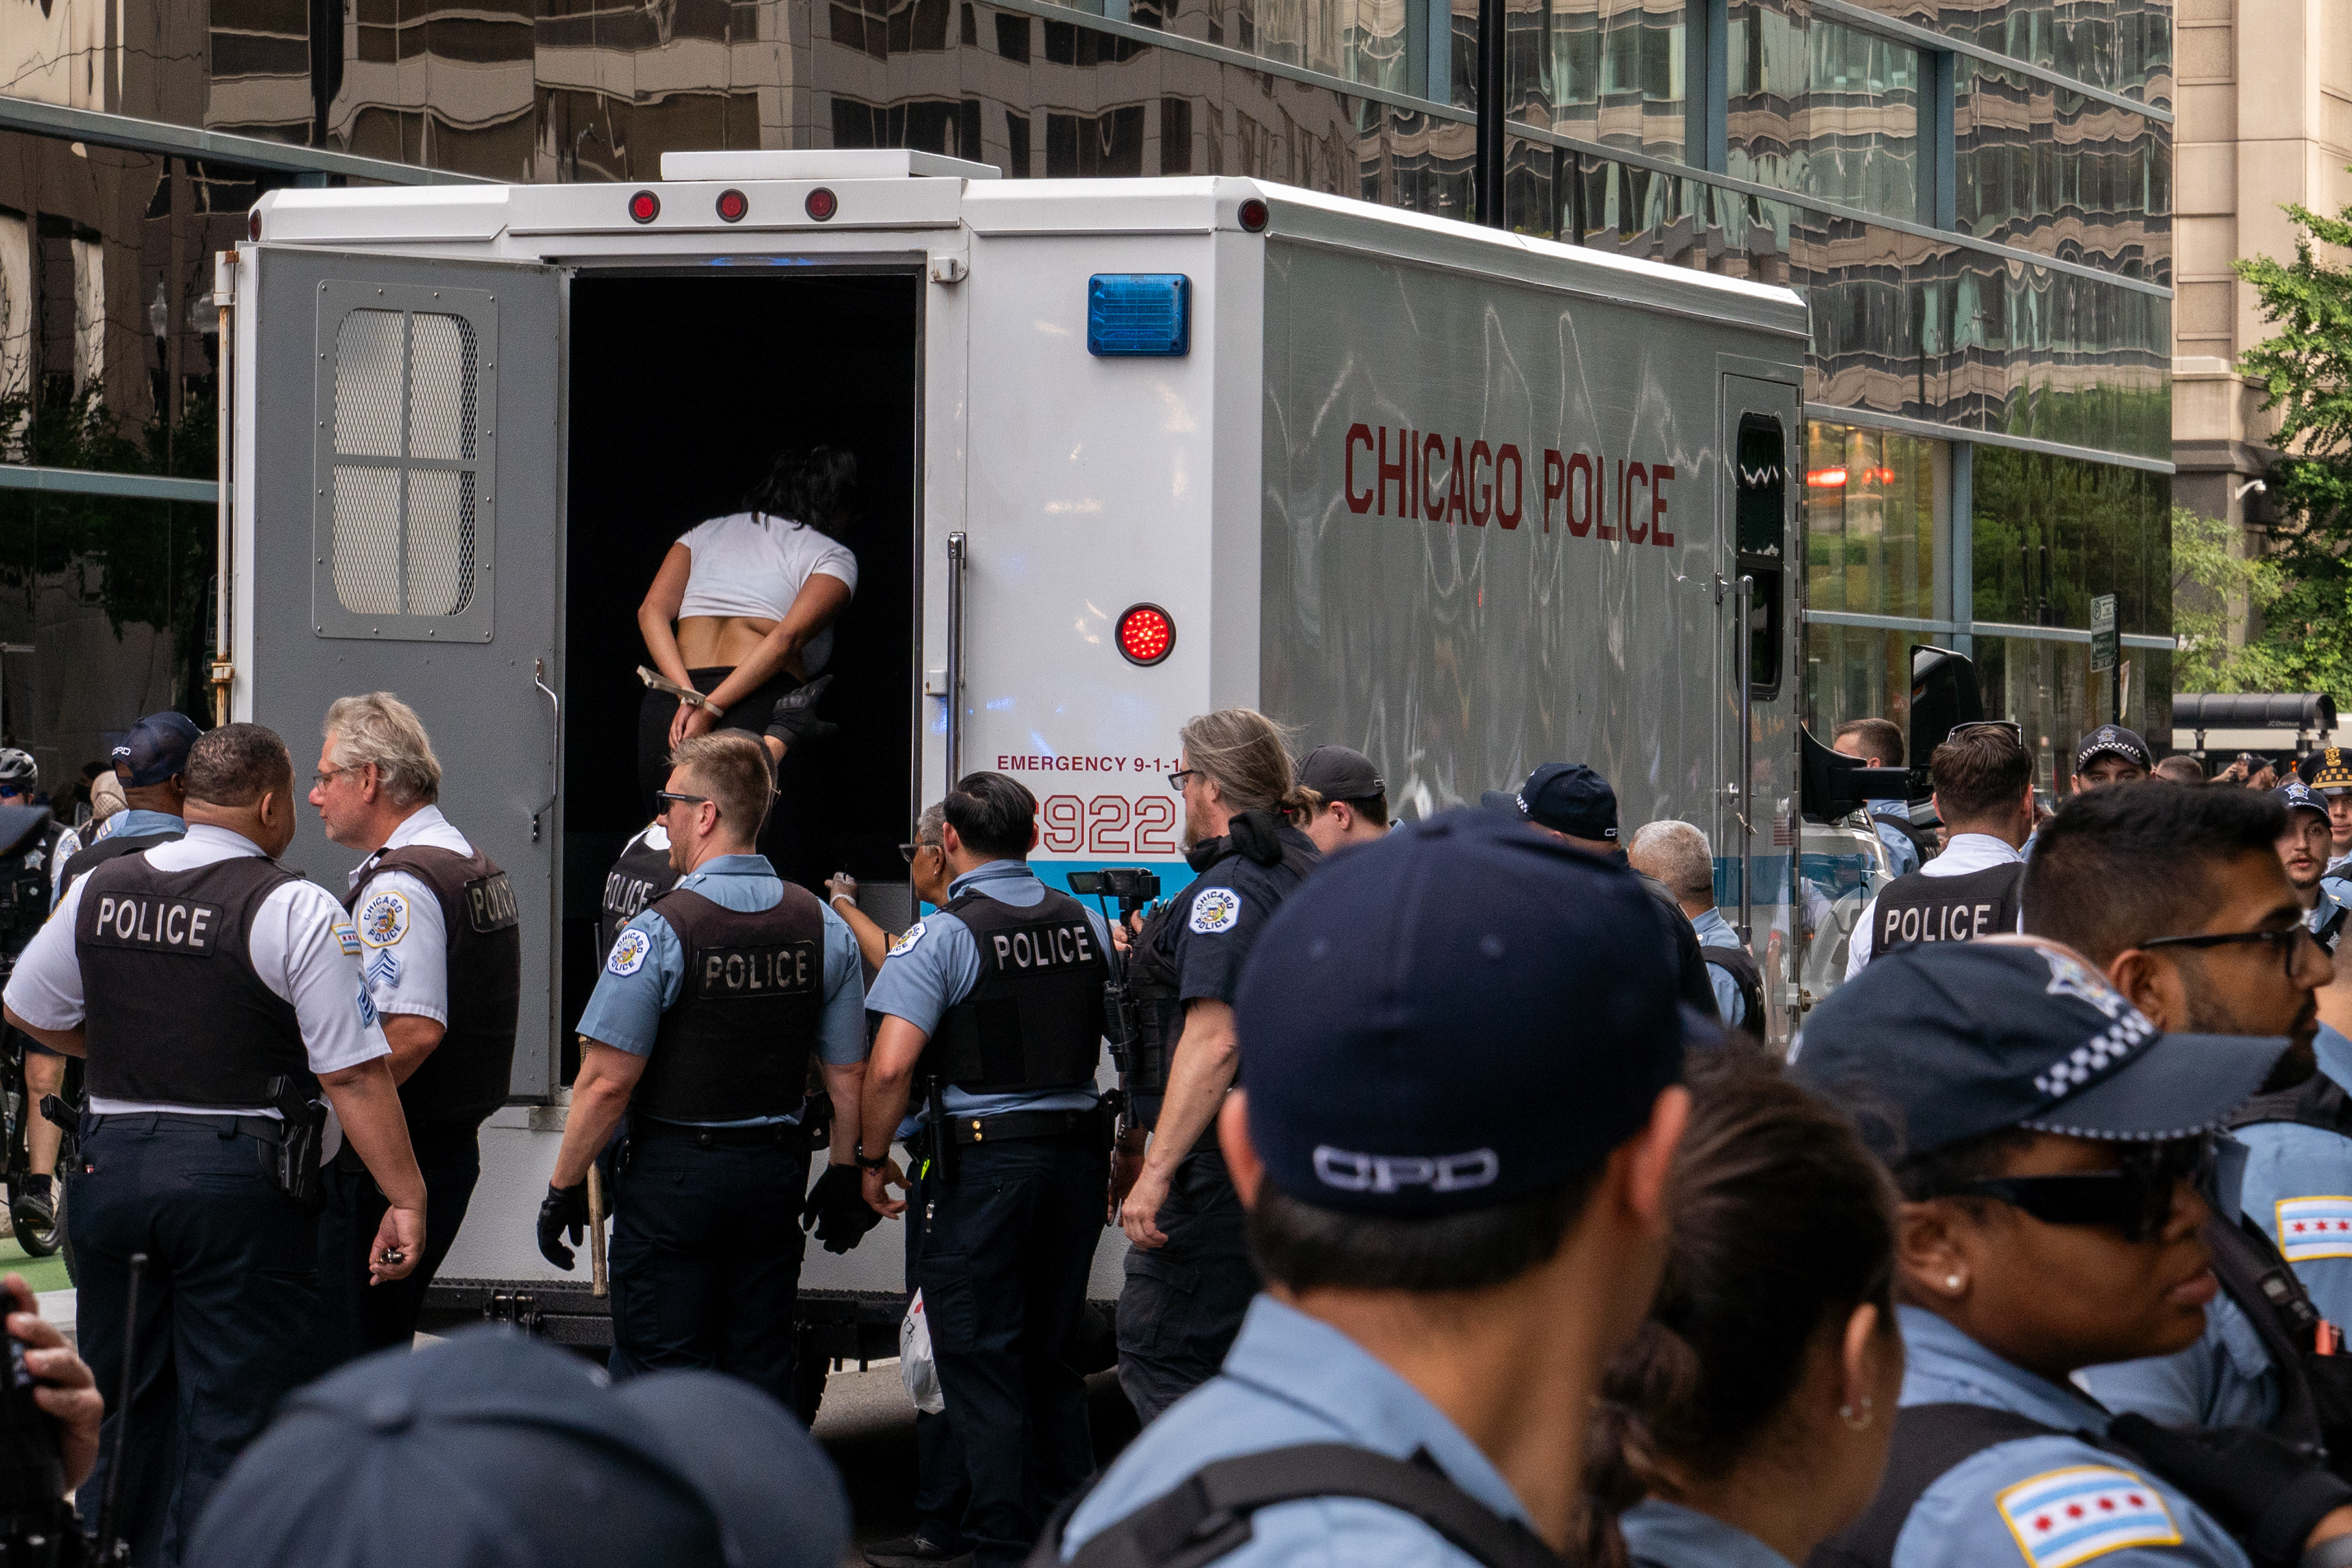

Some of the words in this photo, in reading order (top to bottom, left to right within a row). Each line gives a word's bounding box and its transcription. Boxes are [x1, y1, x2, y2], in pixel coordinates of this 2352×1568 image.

[1345, 423, 1523, 530] CHICAGO
[1544, 448, 1675, 548] POLICE
[111, 746, 131, 756] CPD
[997, 755, 1127, 772] EMERGENCY
[1133, 758, 1179, 772] 9-1-1
[1029, 794, 1176, 854] 922
[363, 895, 403, 921] CHICAGO
[603, 871, 654, 916] POLICE
[1196, 891, 1234, 911] CHICAGO
[96, 897, 212, 947] POLICE
[368, 924, 402, 942] POLICE
[1194, 916, 1230, 930] POLICE
[1884, 904, 1991, 944] POLICE
[617, 932, 643, 953] CHICAGO
[993, 925, 1092, 971] POLICE
[611, 955, 635, 971] POLICE
[706, 949, 807, 990] POLICE
[1313, 1144, 1499, 1193] CPD
